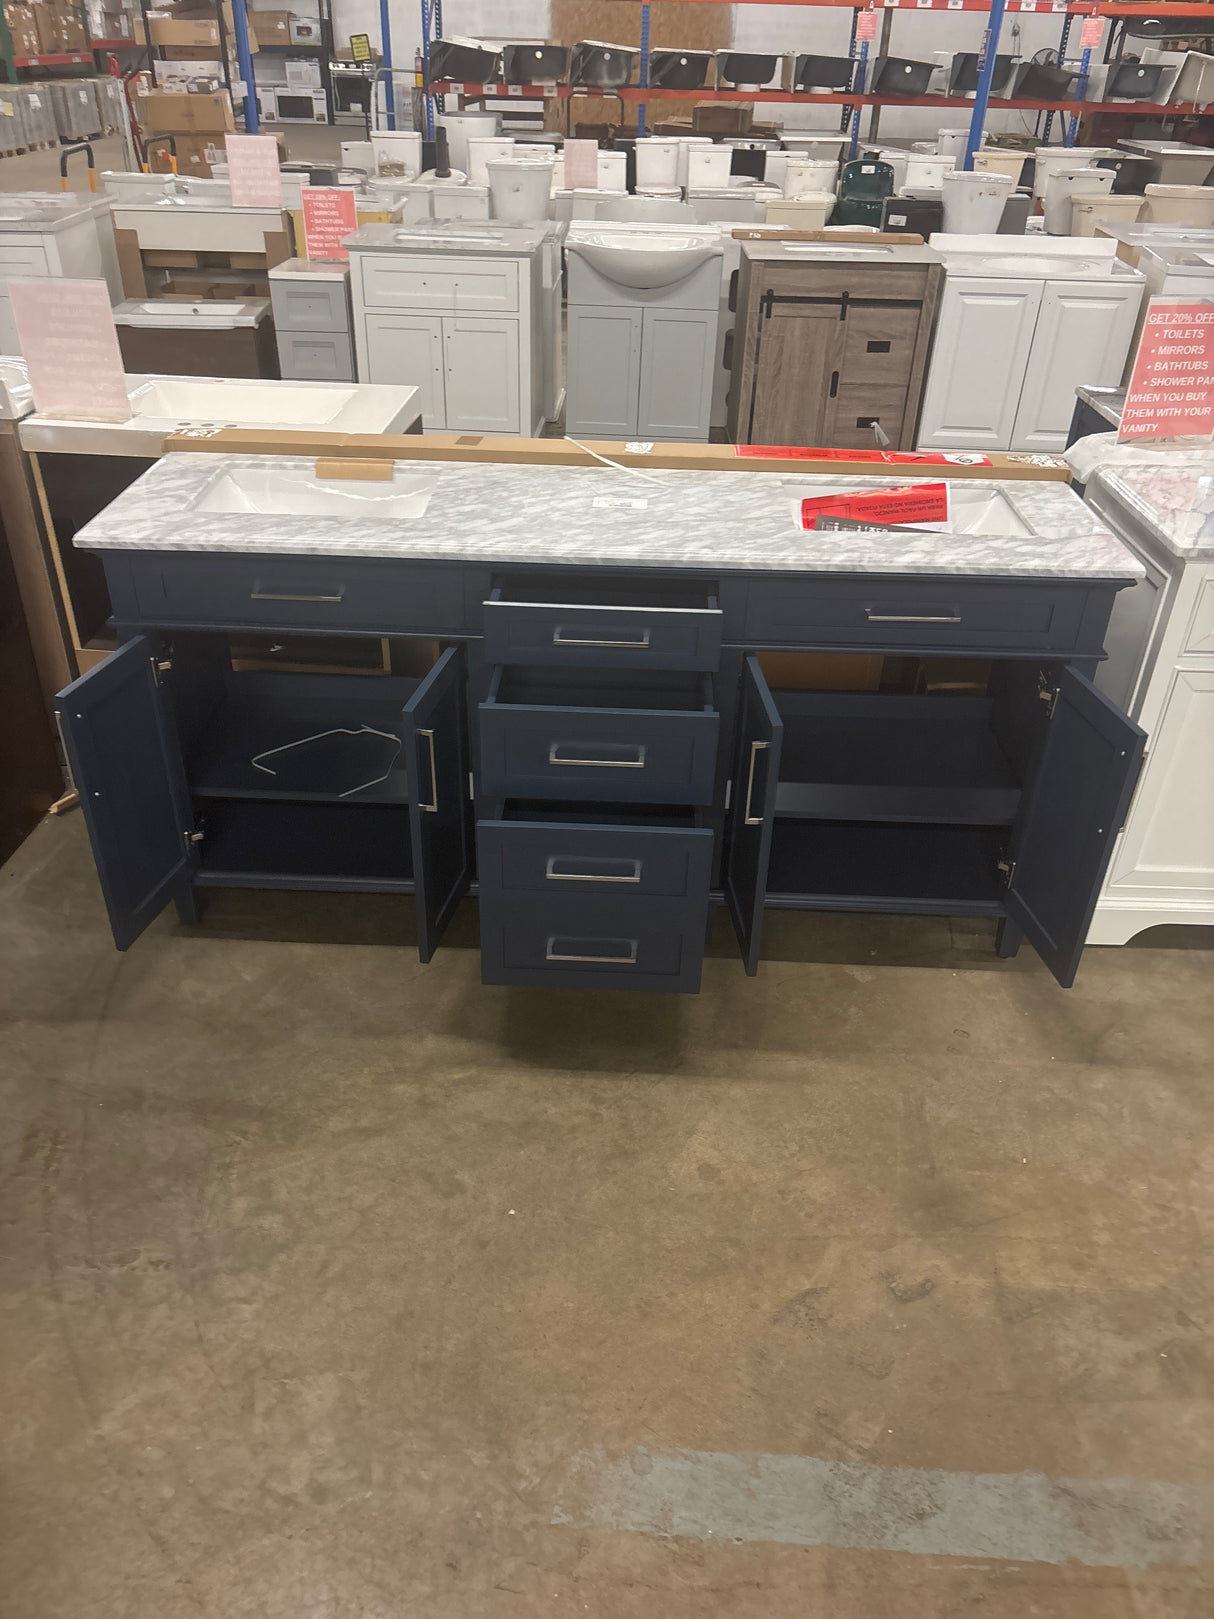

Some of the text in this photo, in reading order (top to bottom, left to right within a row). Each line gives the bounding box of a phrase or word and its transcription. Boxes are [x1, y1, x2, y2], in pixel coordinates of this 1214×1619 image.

[1148, 313, 1171, 323] GET
[1172, 313, 1193, 323] 20%
[1162, 329, 1205, 339] TOILETS
[1157, 345, 1206, 355] MIRRORS
[1153, 361, 1208, 371] BATHTUBS
[1150, 377, 1195, 387] SHOWER
[1129, 391, 1208, 403] WHEN YOU BUY
[1126, 407, 1212, 418] THEM WITH YOUR
[1122, 423, 1159, 433] VANITY
